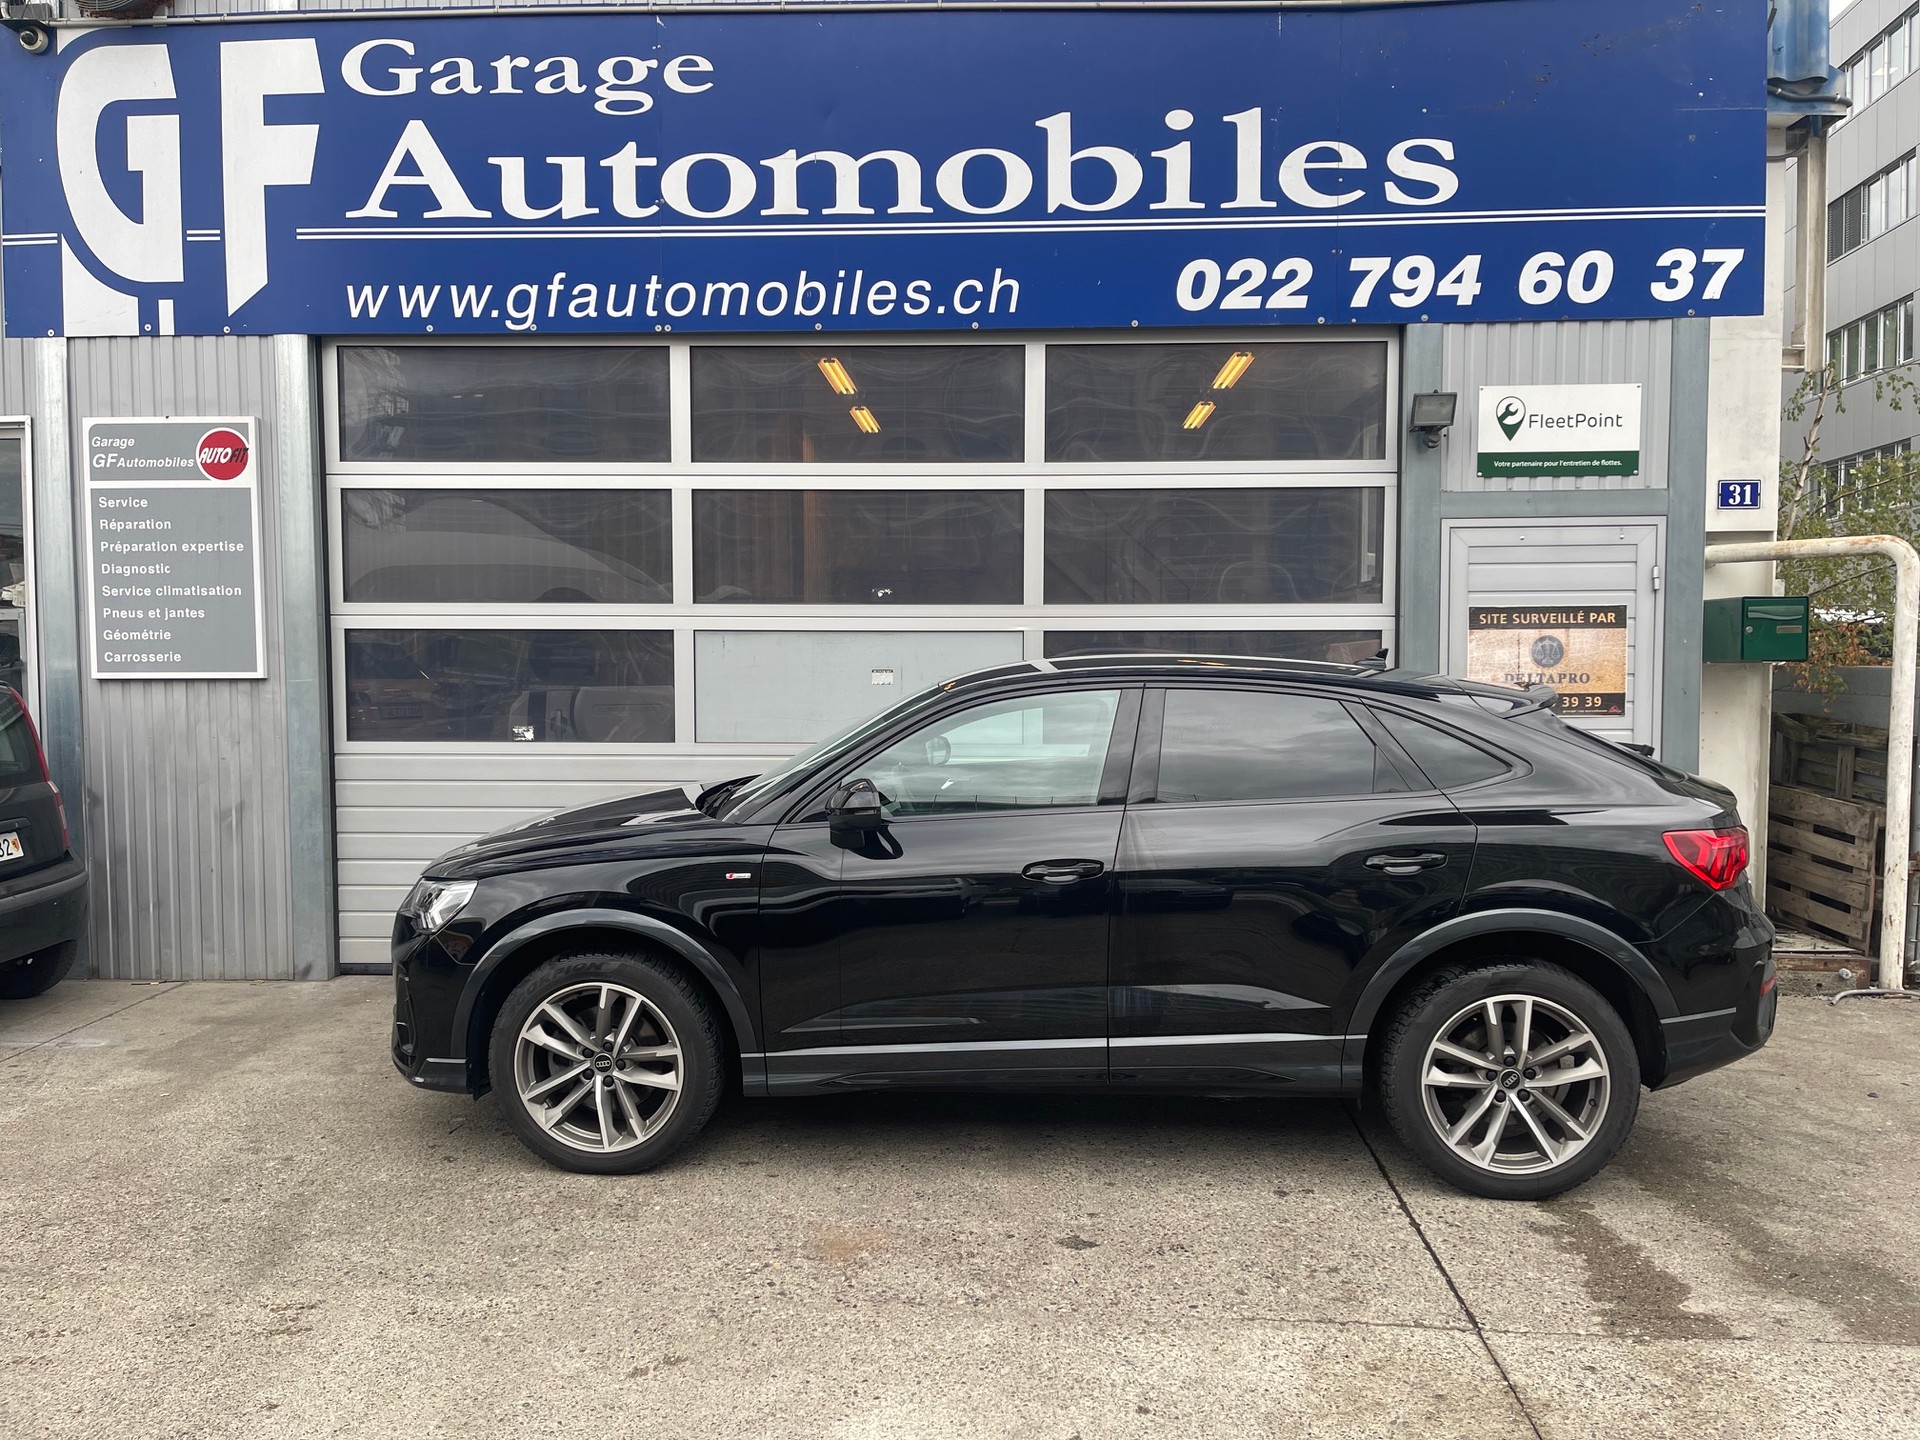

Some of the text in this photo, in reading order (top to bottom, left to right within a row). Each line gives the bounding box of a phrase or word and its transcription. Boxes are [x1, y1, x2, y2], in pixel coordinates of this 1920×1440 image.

[341, 38, 714, 116] Garage
[345, 107, 1459, 220] Automobiles
[56, 38, 326, 317] GF
[1175, 247, 1744, 312] 022 794 60 37
[345, 268, 1021, 331] www.gfautomobiles.ch
[1528, 412, 1623, 429] FleetPoint
[91, 436, 135, 450] Garage
[200, 447, 249, 464] AUTOFIT
[1493, 460, 1511, 468] Votre
[1511, 460, 1543, 469] partenaire
[1559, 459, 1591, 468] l'entretien
[1591, 459, 1601, 467] de
[1601, 459, 1623, 467] flottes.
[1728, 484, 1752, 505] 31
[98, 496, 149, 509] Service
[99, 518, 172, 532] Réparation
[100, 541, 244, 555] Préparation expertise
[101, 563, 171, 577] Diagnostic
[101, 585, 242, 597] Service climatisation
[103, 607, 205, 621] Pneus et jantes
[1479, 610, 1616, 625] SITE SURVEILLÉ PAR
[103, 628, 171, 641] Géométrie
[104, 651, 182, 663] Carrosserie
[1504, 672, 1590, 684] DELTAPRO
[1562, 696, 1602, 708] 39 39
